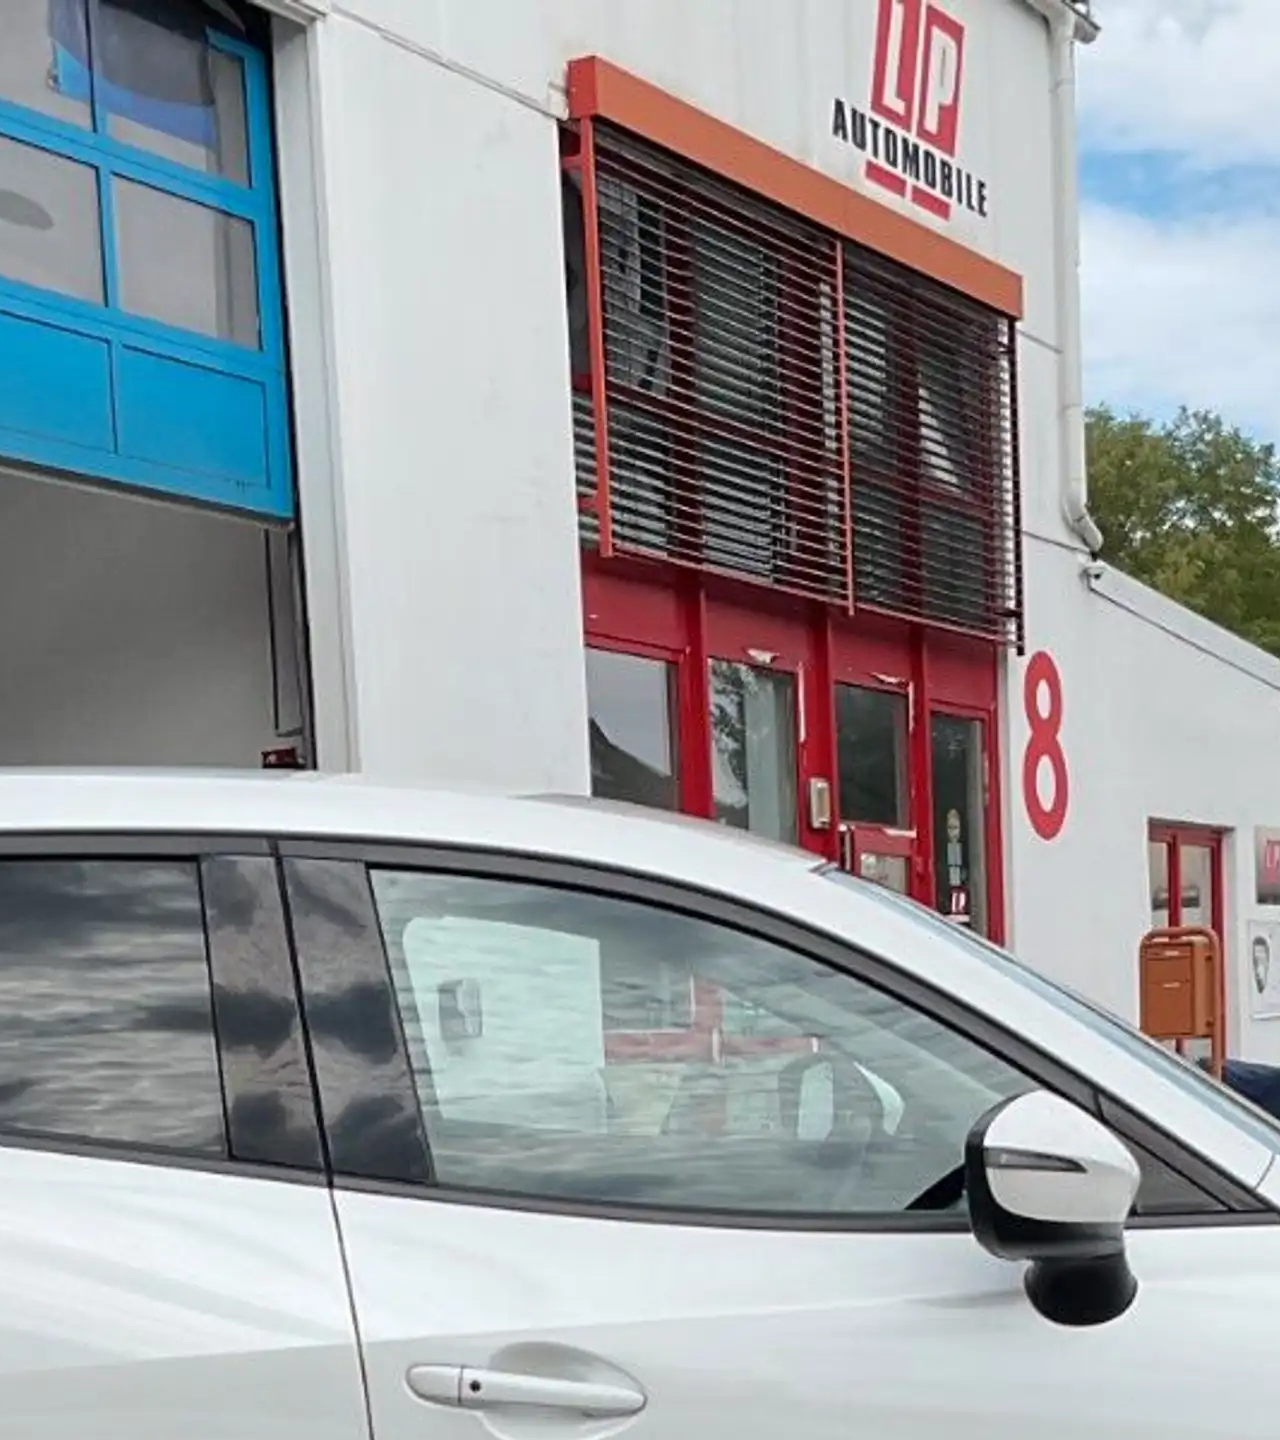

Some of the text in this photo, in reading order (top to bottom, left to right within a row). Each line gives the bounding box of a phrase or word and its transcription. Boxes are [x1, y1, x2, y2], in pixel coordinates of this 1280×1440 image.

[876, 0, 962, 145] LP
[832, 98, 988, 217] AUTOMOBILE
[1023, 650, 1069, 840] 8
